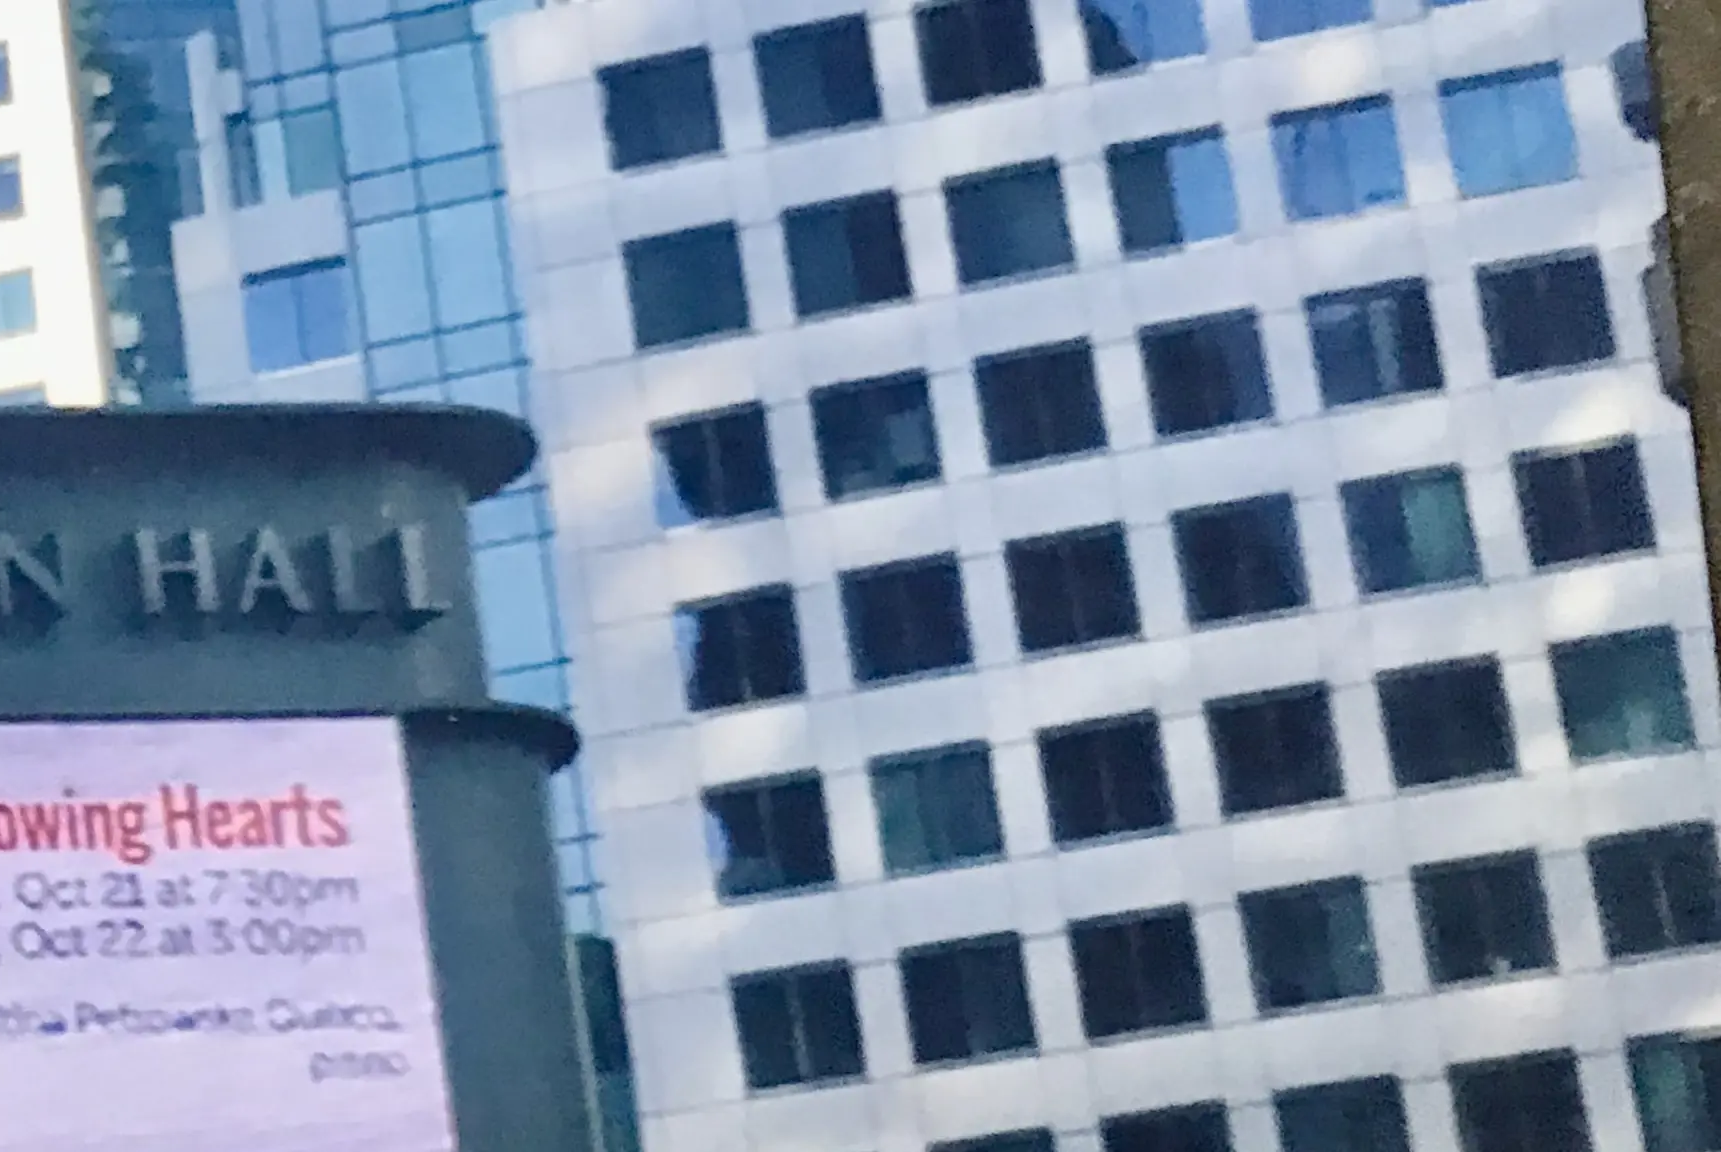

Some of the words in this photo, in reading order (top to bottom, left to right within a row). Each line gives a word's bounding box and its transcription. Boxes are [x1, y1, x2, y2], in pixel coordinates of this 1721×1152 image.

[132, 522, 456, 616] HALL
[158, 780, 353, 850] Hearts
[12, 870, 91, 911] Oct
[100, 870, 145, 909] 21
[155, 875, 197, 907] at
[9, 919, 90, 960] Oct
[95, 918, 150, 958] 22
[155, 923, 198, 957] at
